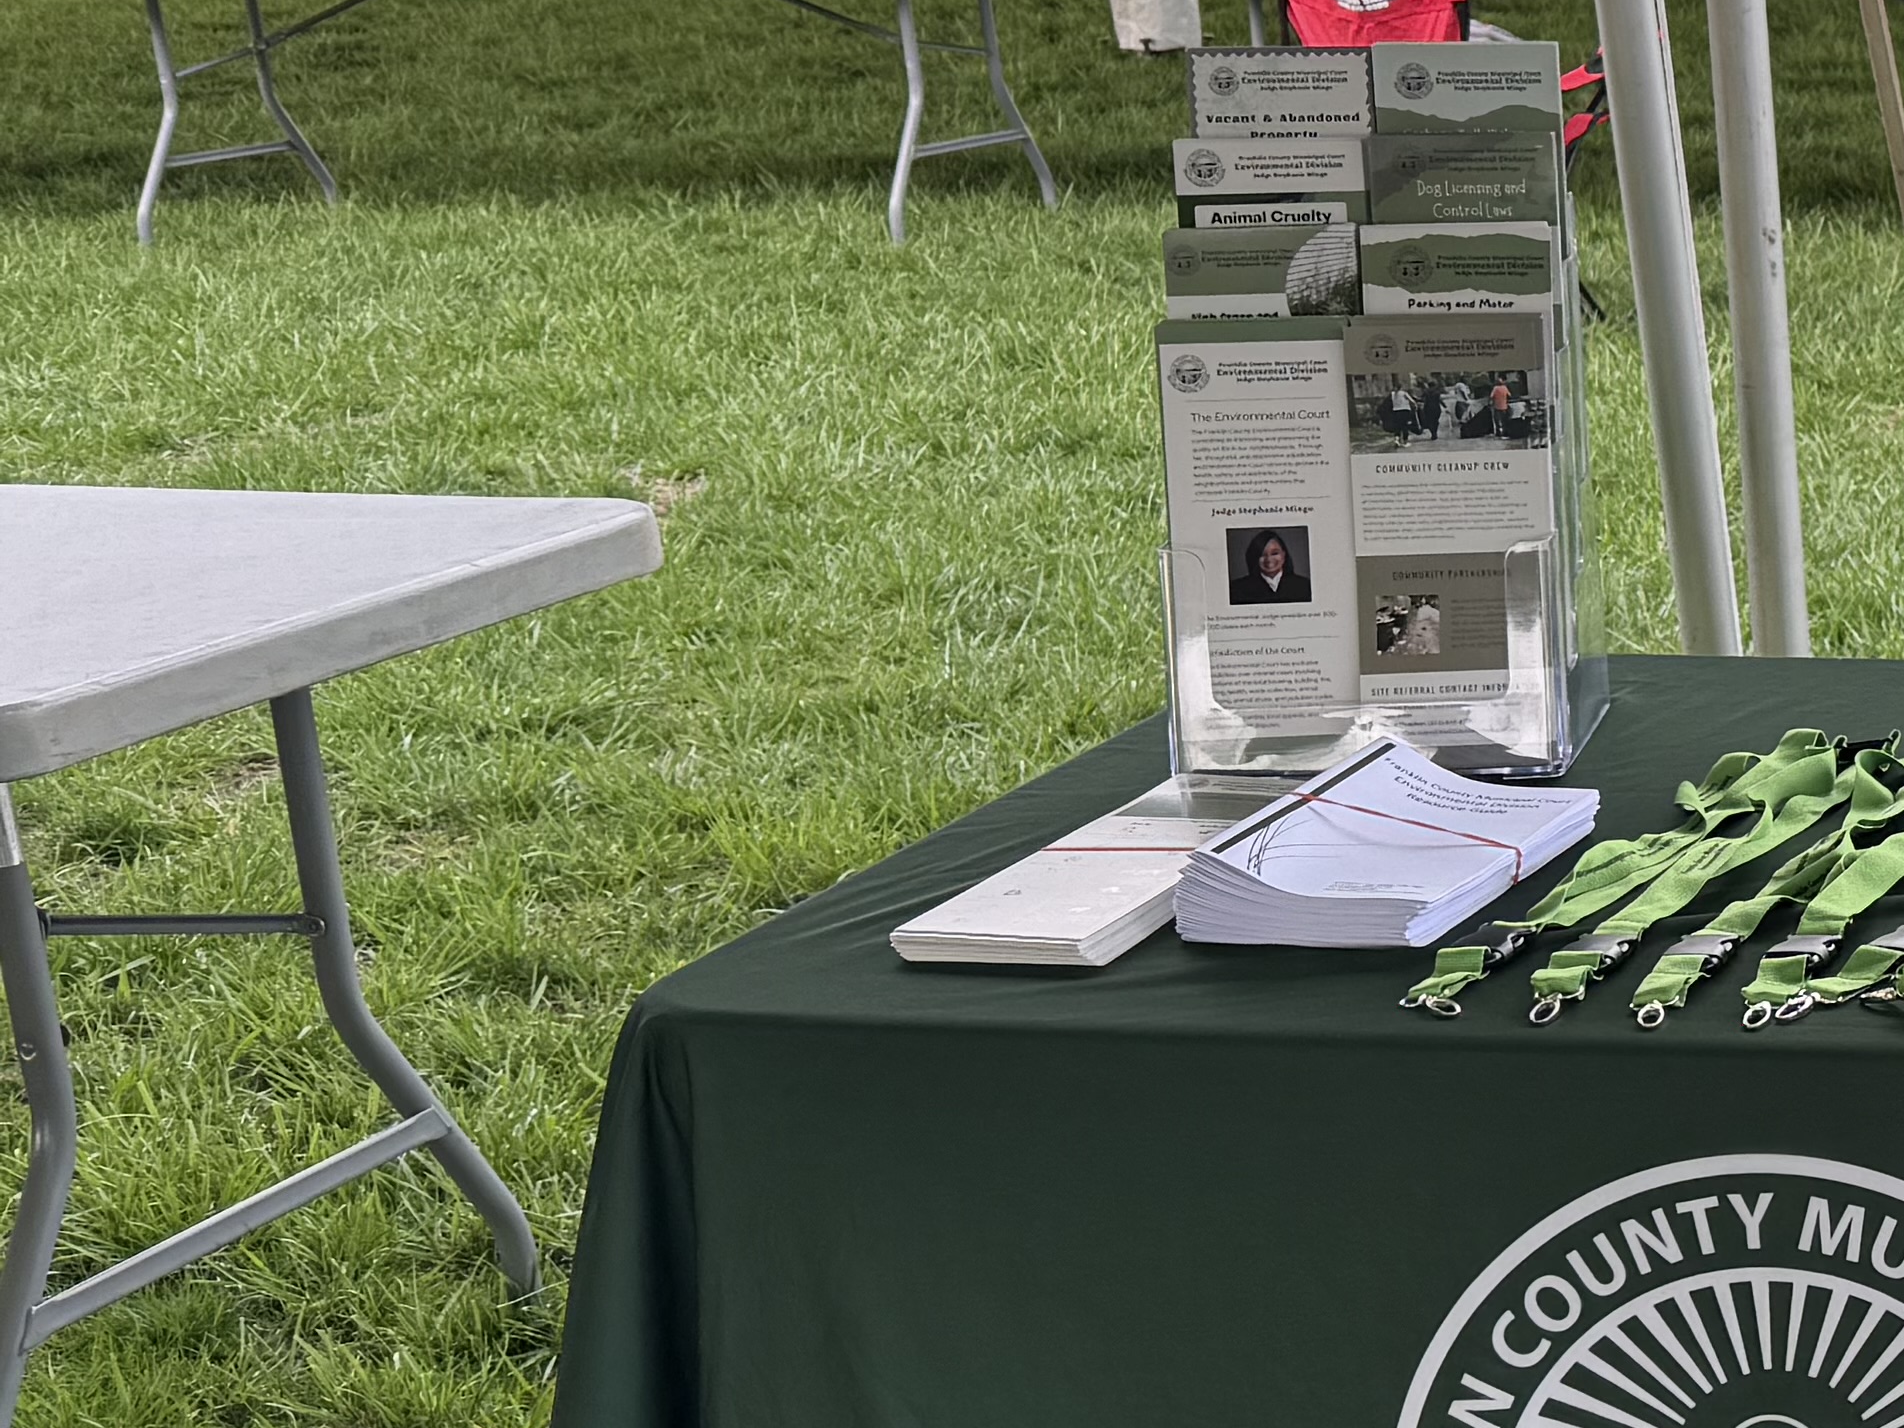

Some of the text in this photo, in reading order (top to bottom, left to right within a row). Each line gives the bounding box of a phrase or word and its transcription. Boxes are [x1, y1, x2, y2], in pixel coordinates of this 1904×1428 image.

[1207, 114, 1255, 123] Vacant
[1280, 112, 1359, 122] Abandoned
[1417, 180, 1442, 197] Dog
[1505, 179, 1526, 193] and
[1433, 202, 1512, 218] Control Laws
[1212, 210, 1331, 224] Animal Cruelty
[1408, 299, 1514, 311] Parking and Motor
[1191, 410, 1330, 422] The Environmental Court
[1376, 464, 1432, 474] COMMUNITY
[1372, 688, 1389, 696] SITE
[1384, 758, 1428, 785] Franklin
[1491, 1192, 1773, 1368] COUNTY
